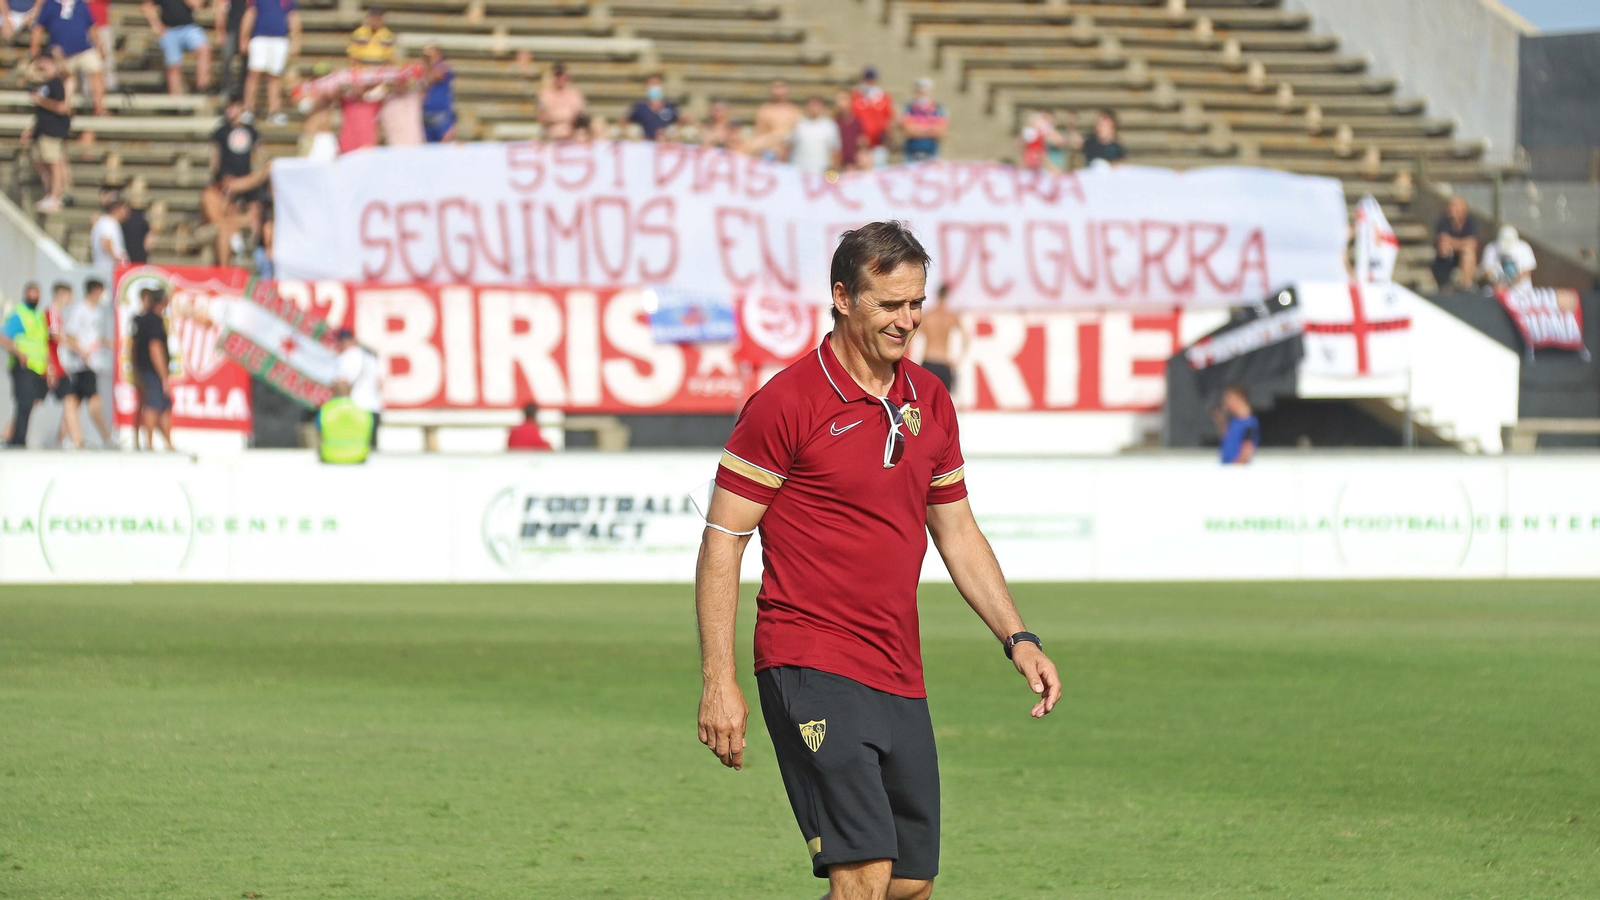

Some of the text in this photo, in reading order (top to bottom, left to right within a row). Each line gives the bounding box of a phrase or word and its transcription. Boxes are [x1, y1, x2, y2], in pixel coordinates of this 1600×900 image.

[359, 196, 681, 283] SEGUIMOS
[713, 204, 800, 293] EN
[937, 219, 1016, 298] DE
[1024, 218, 1271, 300] GUERRA
[353, 285, 686, 407] BIRIS
[114, 384, 252, 420] SILLA
[523, 493, 695, 514] FOOTBALL
[48, 517, 187, 535] FOOTBALL
[197, 517, 339, 534] CENTER
[519, 521, 647, 541] IMPACT
[1204, 514, 1333, 532] MARBELLA
[1342, 513, 1467, 532] FOOTBALL
